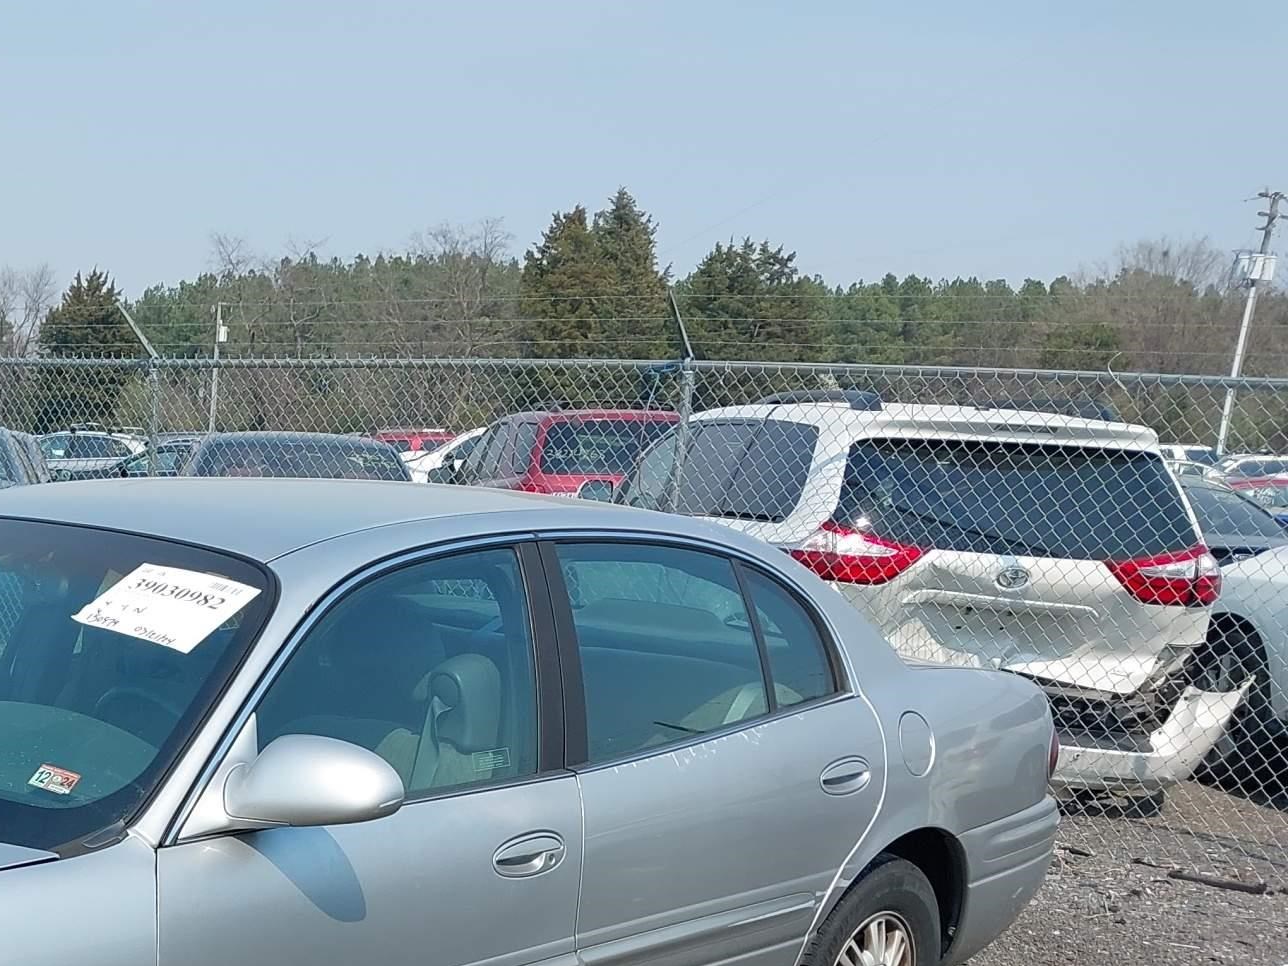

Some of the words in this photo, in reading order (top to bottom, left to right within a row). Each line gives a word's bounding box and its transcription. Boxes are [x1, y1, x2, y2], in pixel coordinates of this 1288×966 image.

[128, 577, 226, 610] 39030982
[34, 769, 52, 784] 12
[60, 776, 76, 789] 24
